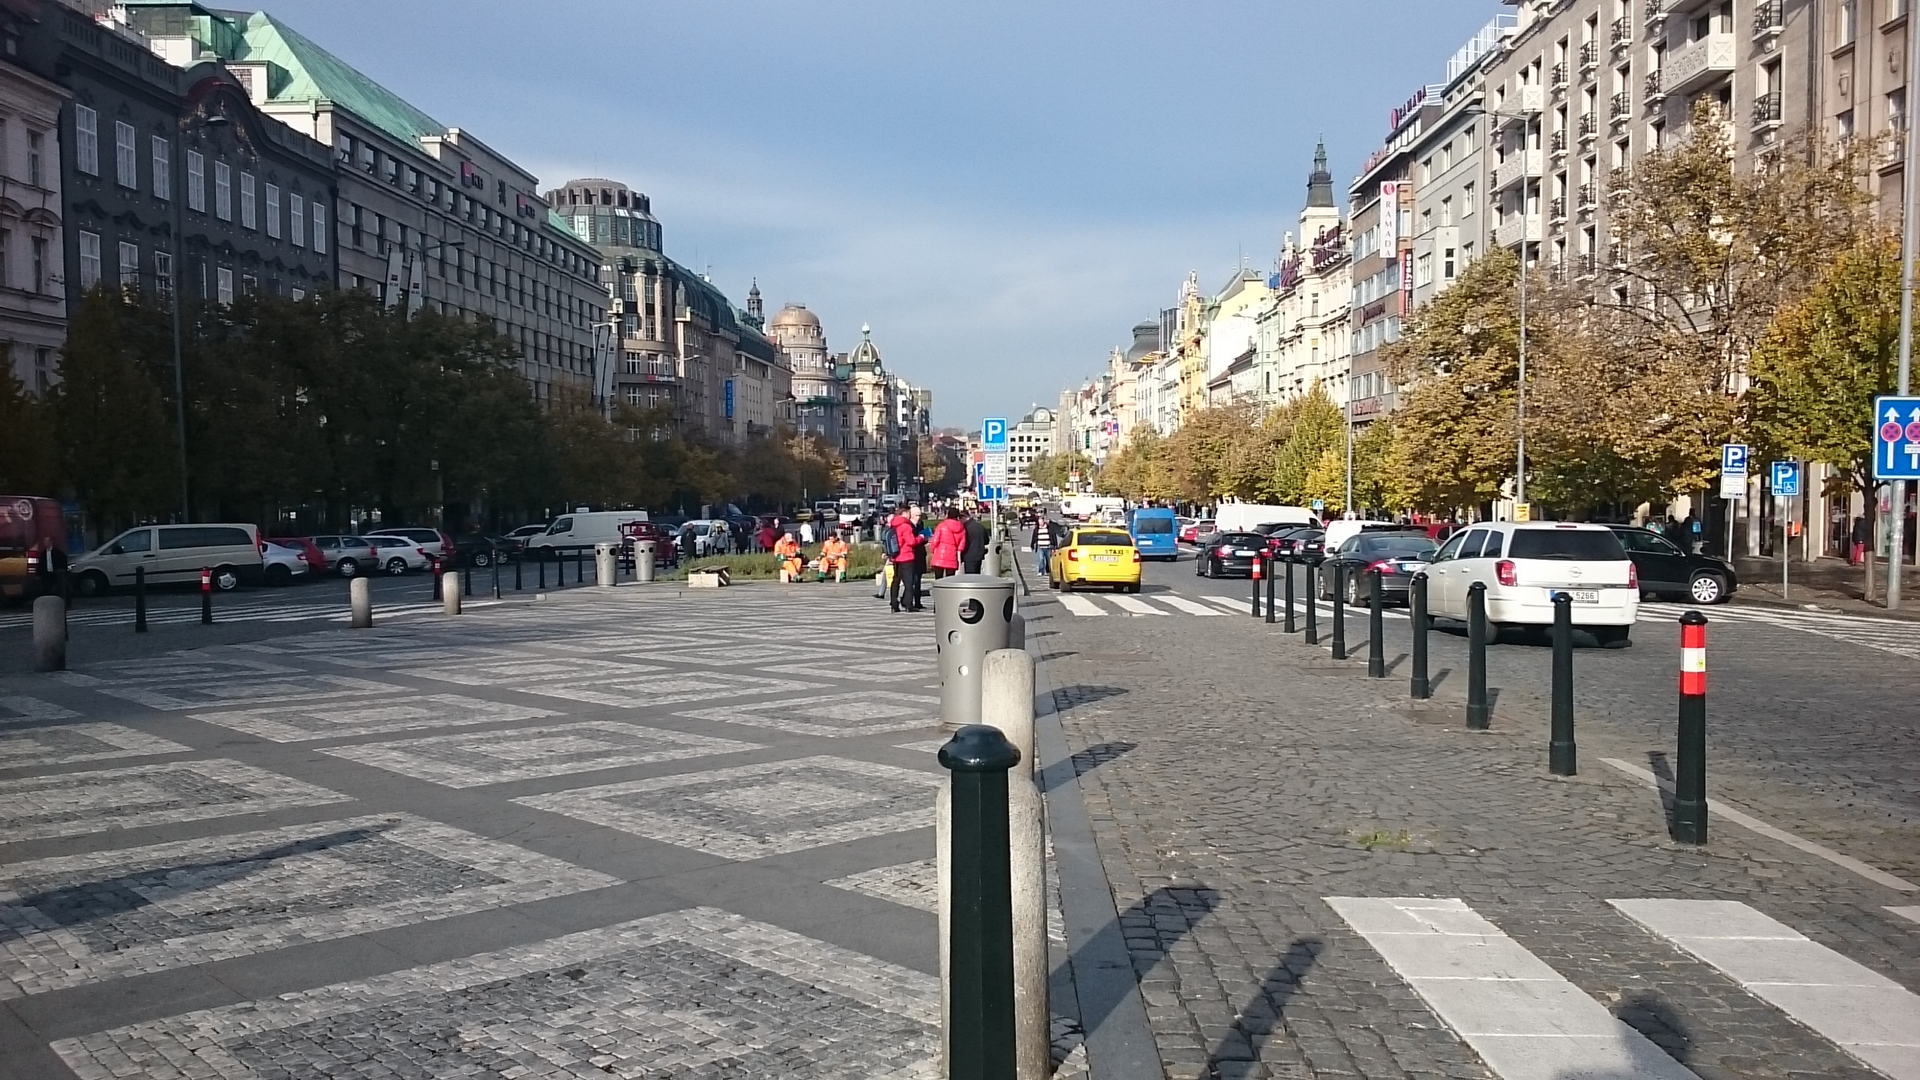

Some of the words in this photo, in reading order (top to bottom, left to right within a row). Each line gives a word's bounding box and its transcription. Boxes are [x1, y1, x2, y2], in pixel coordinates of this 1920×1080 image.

[1398, 85, 1427, 120] RAMADA
[1384, 201, 1392, 257] RAMADA
[987, 421, 1002, 442] P
[1727, 447, 1743, 466] P
[1777, 465, 1793, 485] P
[1576, 592, 1595, 600] 5266
